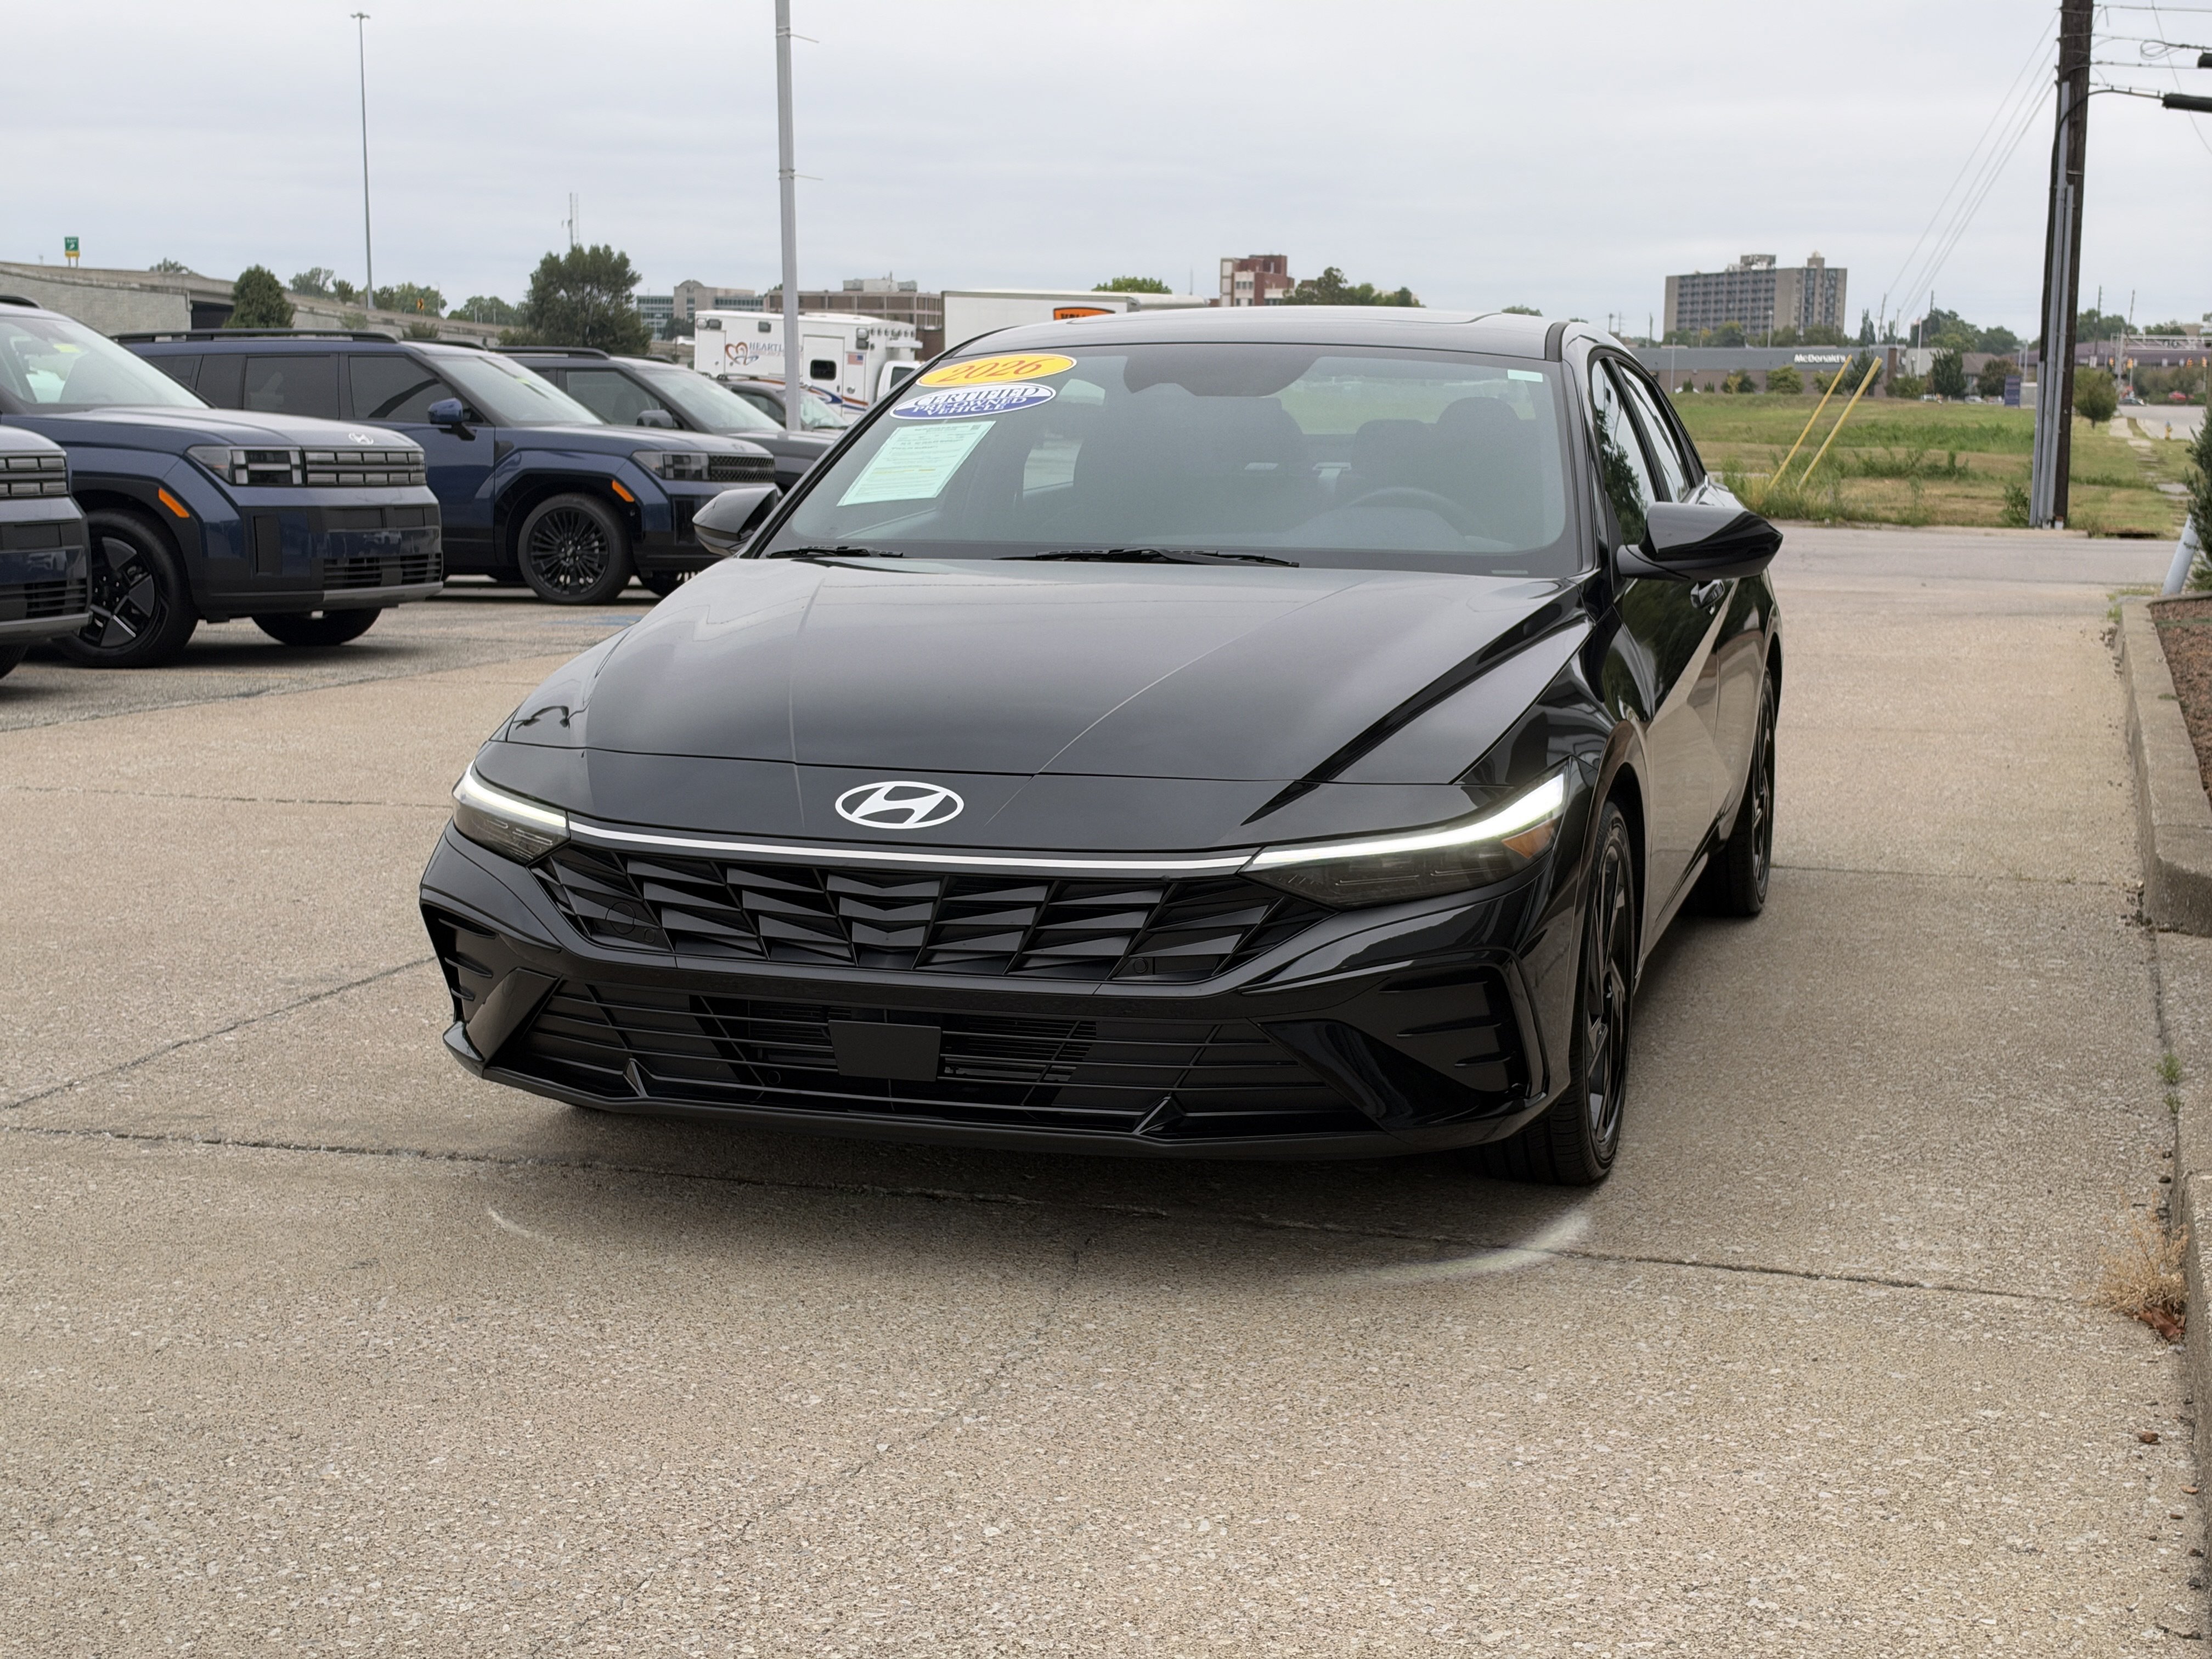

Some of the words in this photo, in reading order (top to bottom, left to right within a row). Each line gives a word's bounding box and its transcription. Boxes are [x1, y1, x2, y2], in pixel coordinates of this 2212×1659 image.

[1795, 354, 1846, 363] McDonald's
[936, 358, 1054, 383] 2026
[914, 387, 1040, 406] CERTIFIED
[912, 397, 1027, 413] PRE-OWNED
[926, 403, 1006, 415] VEHICLE
